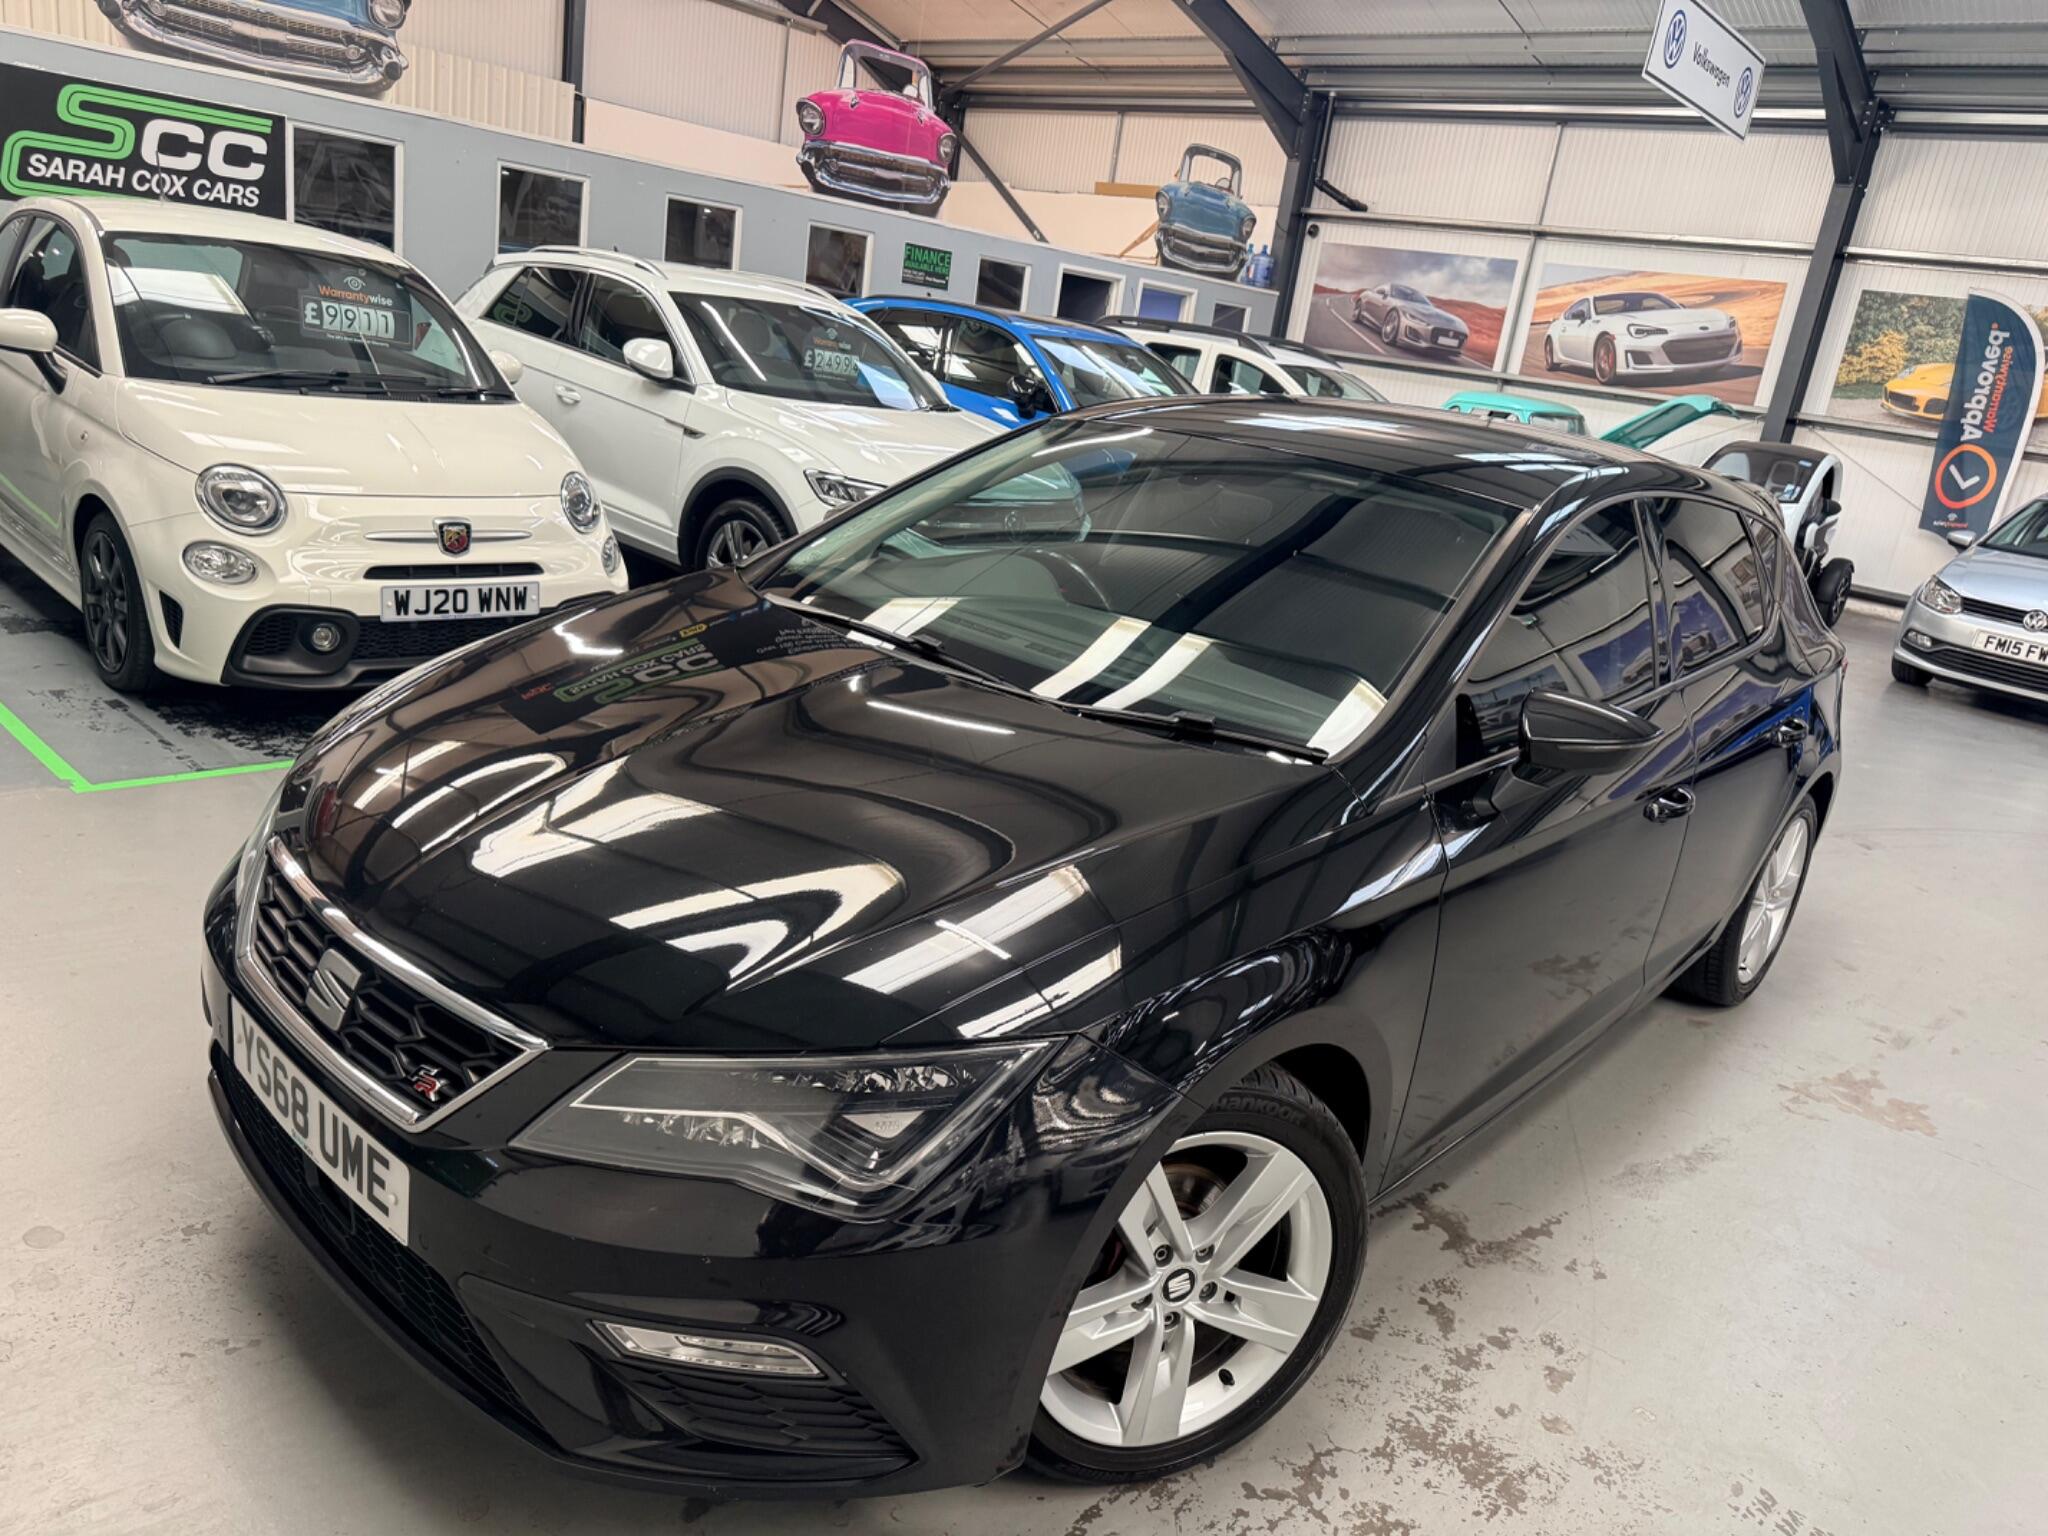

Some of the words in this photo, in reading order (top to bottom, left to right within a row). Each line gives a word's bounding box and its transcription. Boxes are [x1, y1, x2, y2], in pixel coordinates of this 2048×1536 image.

[1693, 41, 1730, 88] Volkswagen
[1, 84, 273, 196] SCC
[27, 153, 125, 188] SARAH
[131, 169, 188, 198] COX
[192, 178, 260, 208] CARS
[904, 246, 950, 267] FINANCE
[319, 284, 393, 306] Warrantywise
[394, 588, 468, 616] WJ20
[478, 586, 528, 613] WNW
[1983, 635, 2025, 656] FM15
[241, 1014, 309, 1140] YS68
[319, 1100, 390, 1218] UME
